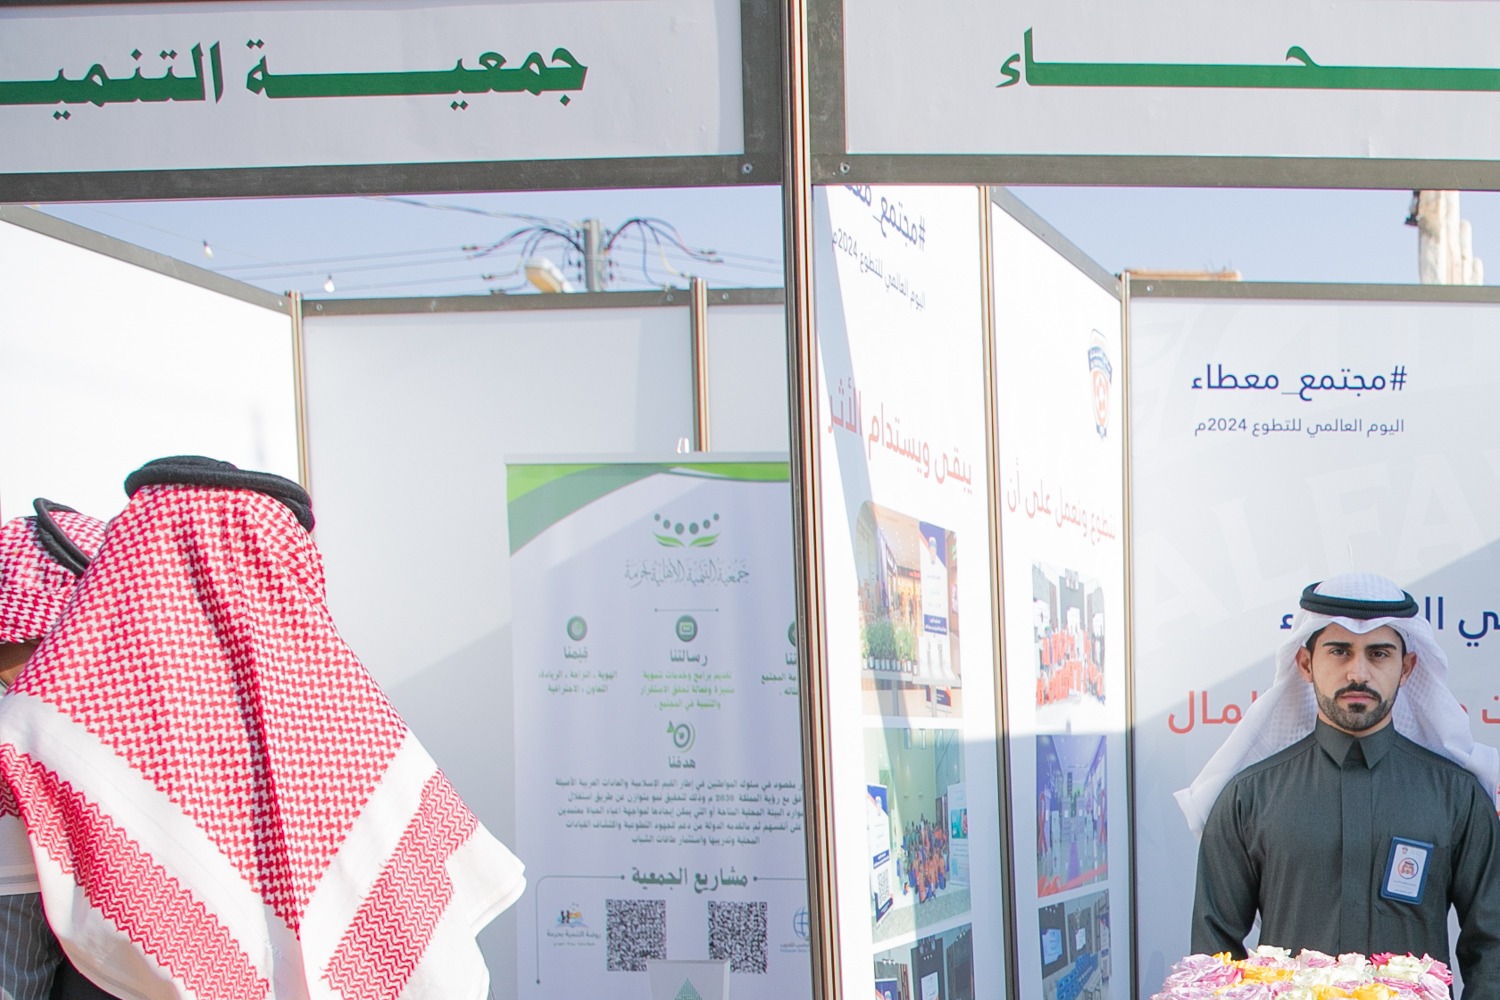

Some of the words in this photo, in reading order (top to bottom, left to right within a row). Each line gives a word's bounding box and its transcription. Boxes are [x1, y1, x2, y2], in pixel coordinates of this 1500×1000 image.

[0, 40, 224, 121] التنمي
[246, 37, 589, 111] جمعية
[867, 402, 931, 478] ويستدام
[1251, 418, 1302, 438] للتطوع
[1306, 418, 1363, 438] العالمي
[1366, 418, 1405, 438] اليوم
[631, 866, 688, 891] الجمعية
[693, 866, 748, 894] مشاريع
